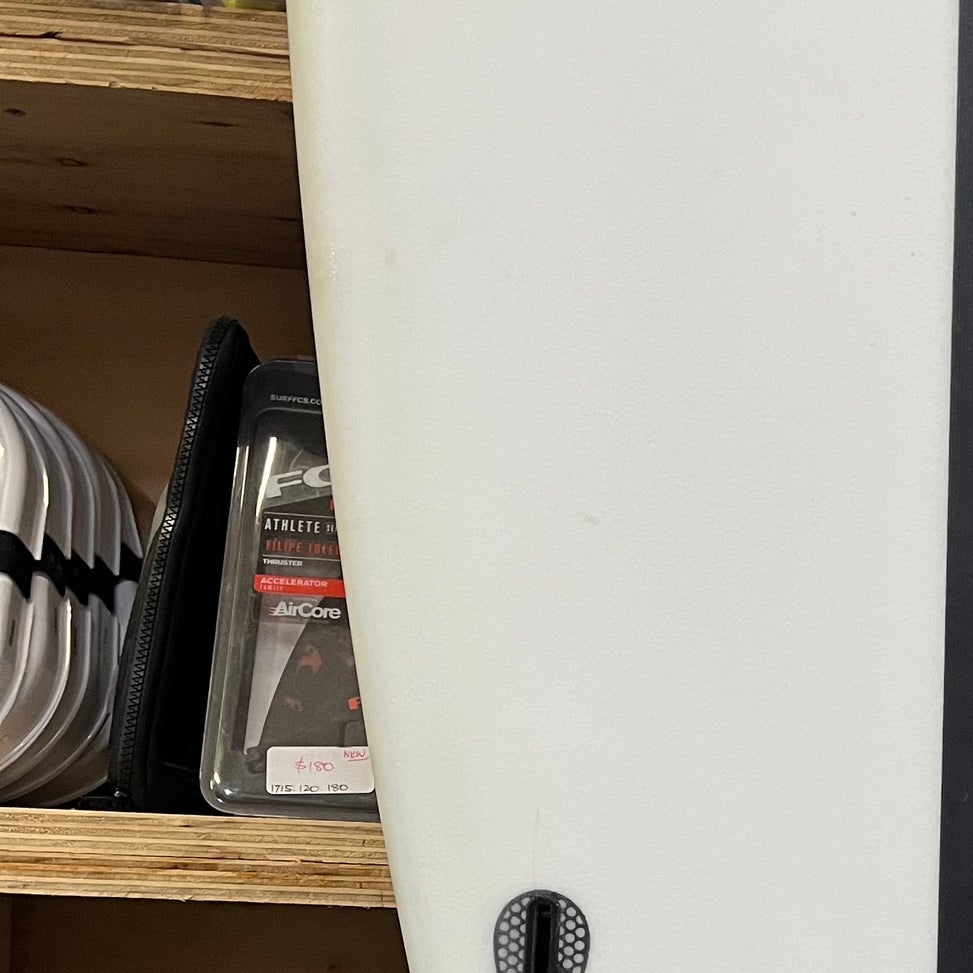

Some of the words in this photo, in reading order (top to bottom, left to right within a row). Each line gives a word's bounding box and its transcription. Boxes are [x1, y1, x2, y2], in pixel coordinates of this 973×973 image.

[264, 518, 321, 534] ATHLETE
[262, 558, 303, 567] THRUSTER
[260, 577, 328, 588] ACCELERATOR
[270, 600, 341, 619] AirCore
[343, 749, 366, 759] NEW
[295, 756, 334, 775] $180
